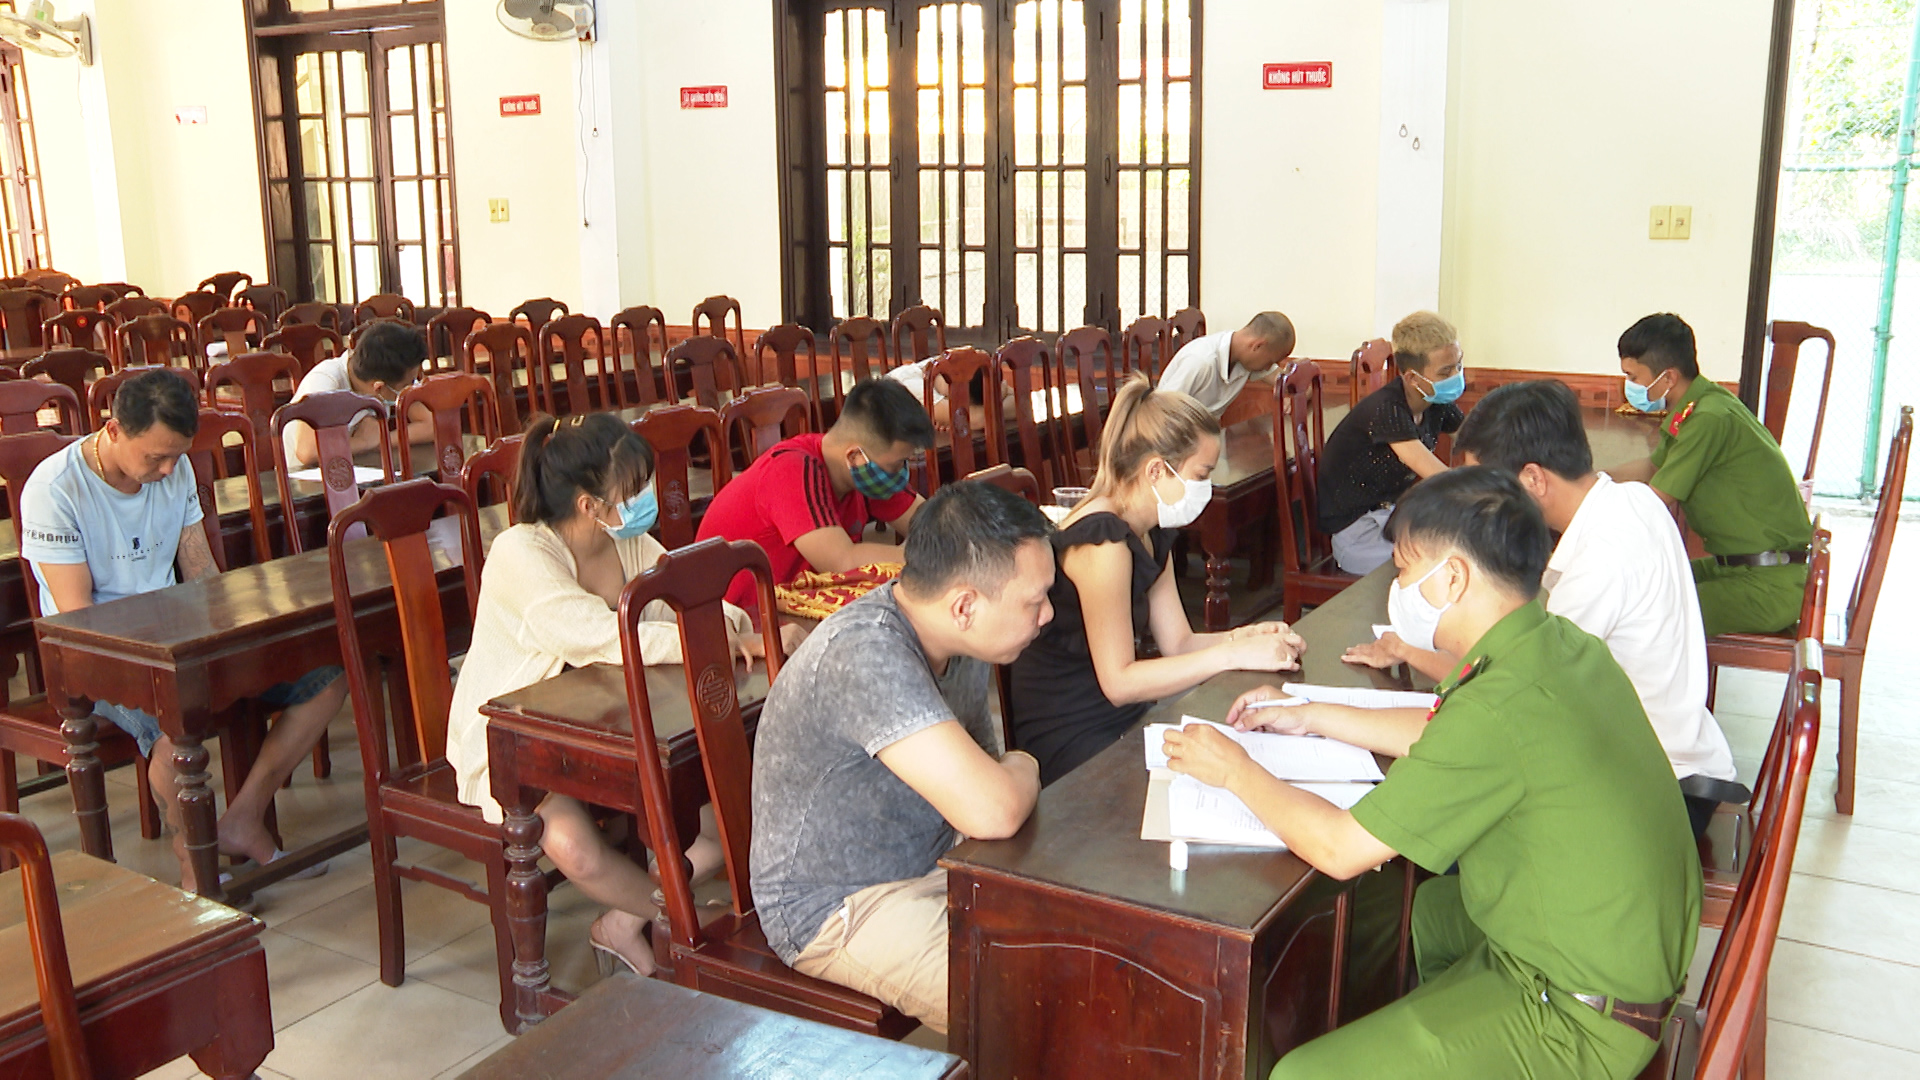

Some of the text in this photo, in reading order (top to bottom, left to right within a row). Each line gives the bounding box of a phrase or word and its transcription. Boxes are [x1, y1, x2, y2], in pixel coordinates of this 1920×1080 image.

[1269, 67, 1327, 84] KHÔNG HÚT THUỐC
